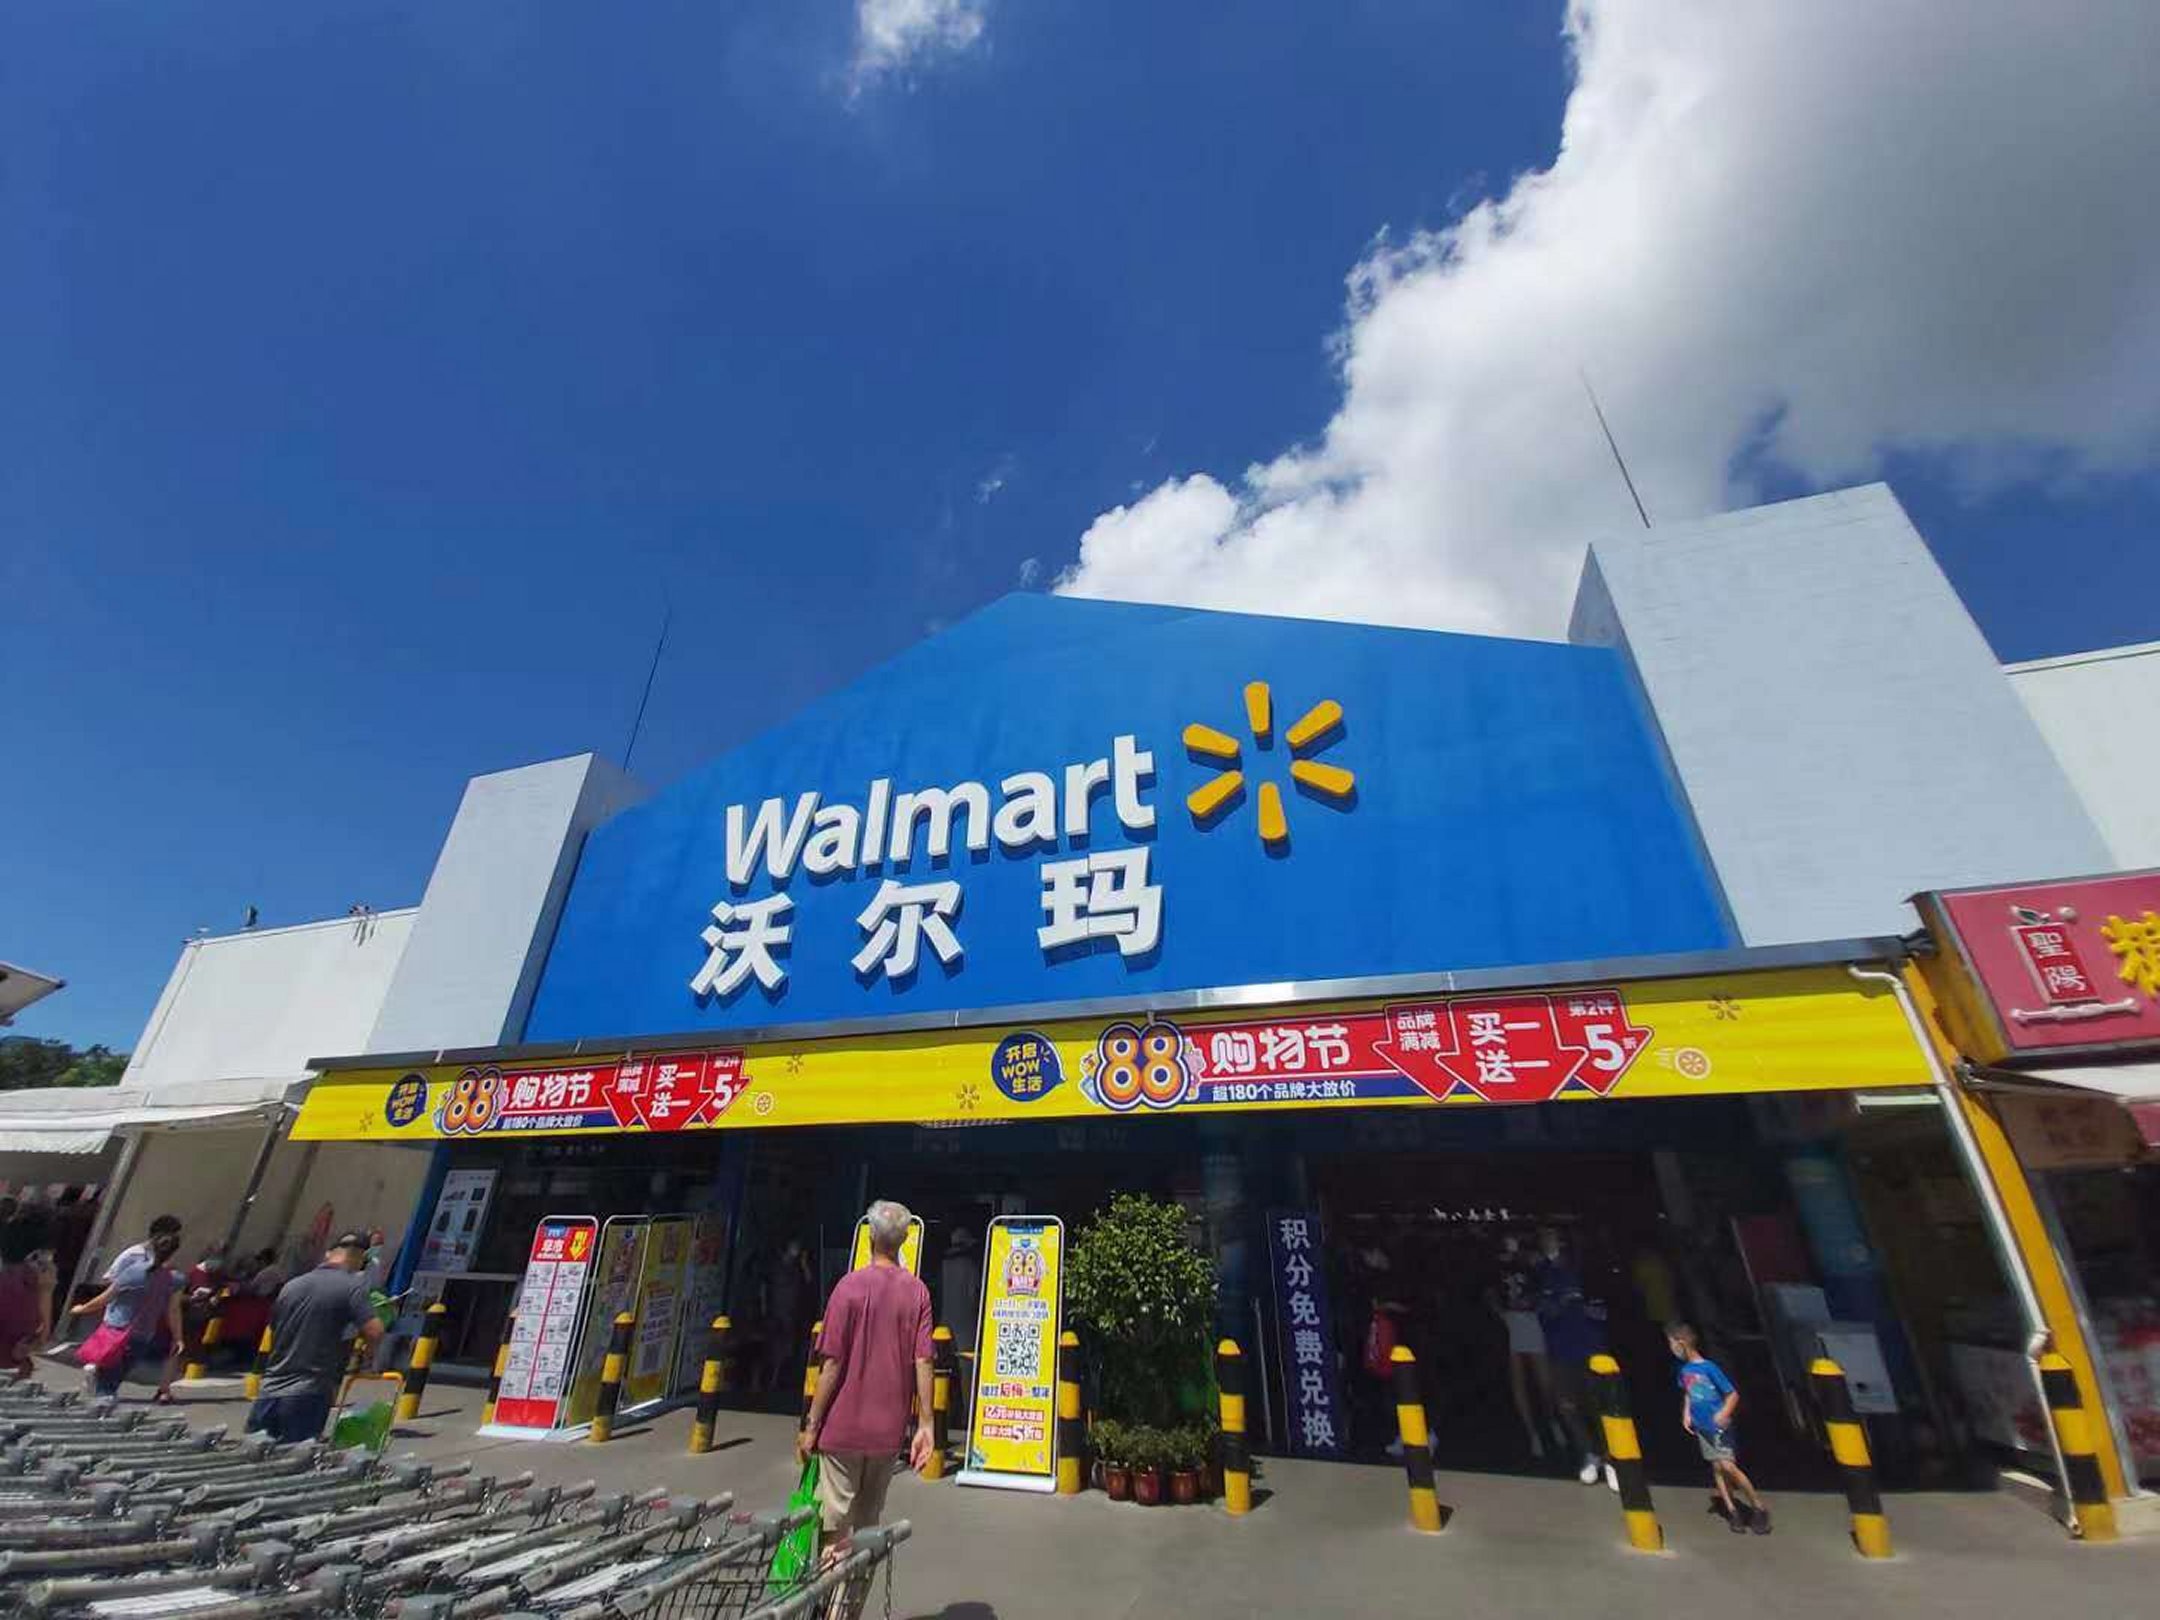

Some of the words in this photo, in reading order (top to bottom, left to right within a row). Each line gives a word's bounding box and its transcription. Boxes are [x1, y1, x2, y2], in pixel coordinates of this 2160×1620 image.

[726, 734, 1155, 886] Walmart
[690, 846, 1164, 996] 沃尔玛
[1396, 1010, 1437, 1031] 品牌
[1467, 1012, 1541, 1047] 买一
[1005, 1042, 1037, 1063] 开启
[1210, 1023, 1351, 1075] 购物节
[1399, 1030, 1441, 1051] 满减
[655, 1063, 697, 1090] 买一
[1001, 1058, 1041, 1081] WOW
[1099, 1021, 1190, 1112] 88
[1475, 1049, 1551, 1084] 送一
[441, 1065, 502, 1135] 88
[508, 1071, 595, 1109] 购物节
[1012, 1075, 1043, 1094] 生活
[1212, 1079, 1357, 1102] 超180个品牌大放价
[649, 1091, 692, 1118] 送一
[1279, 1218, 1336, 1448] 积分免费兑换
